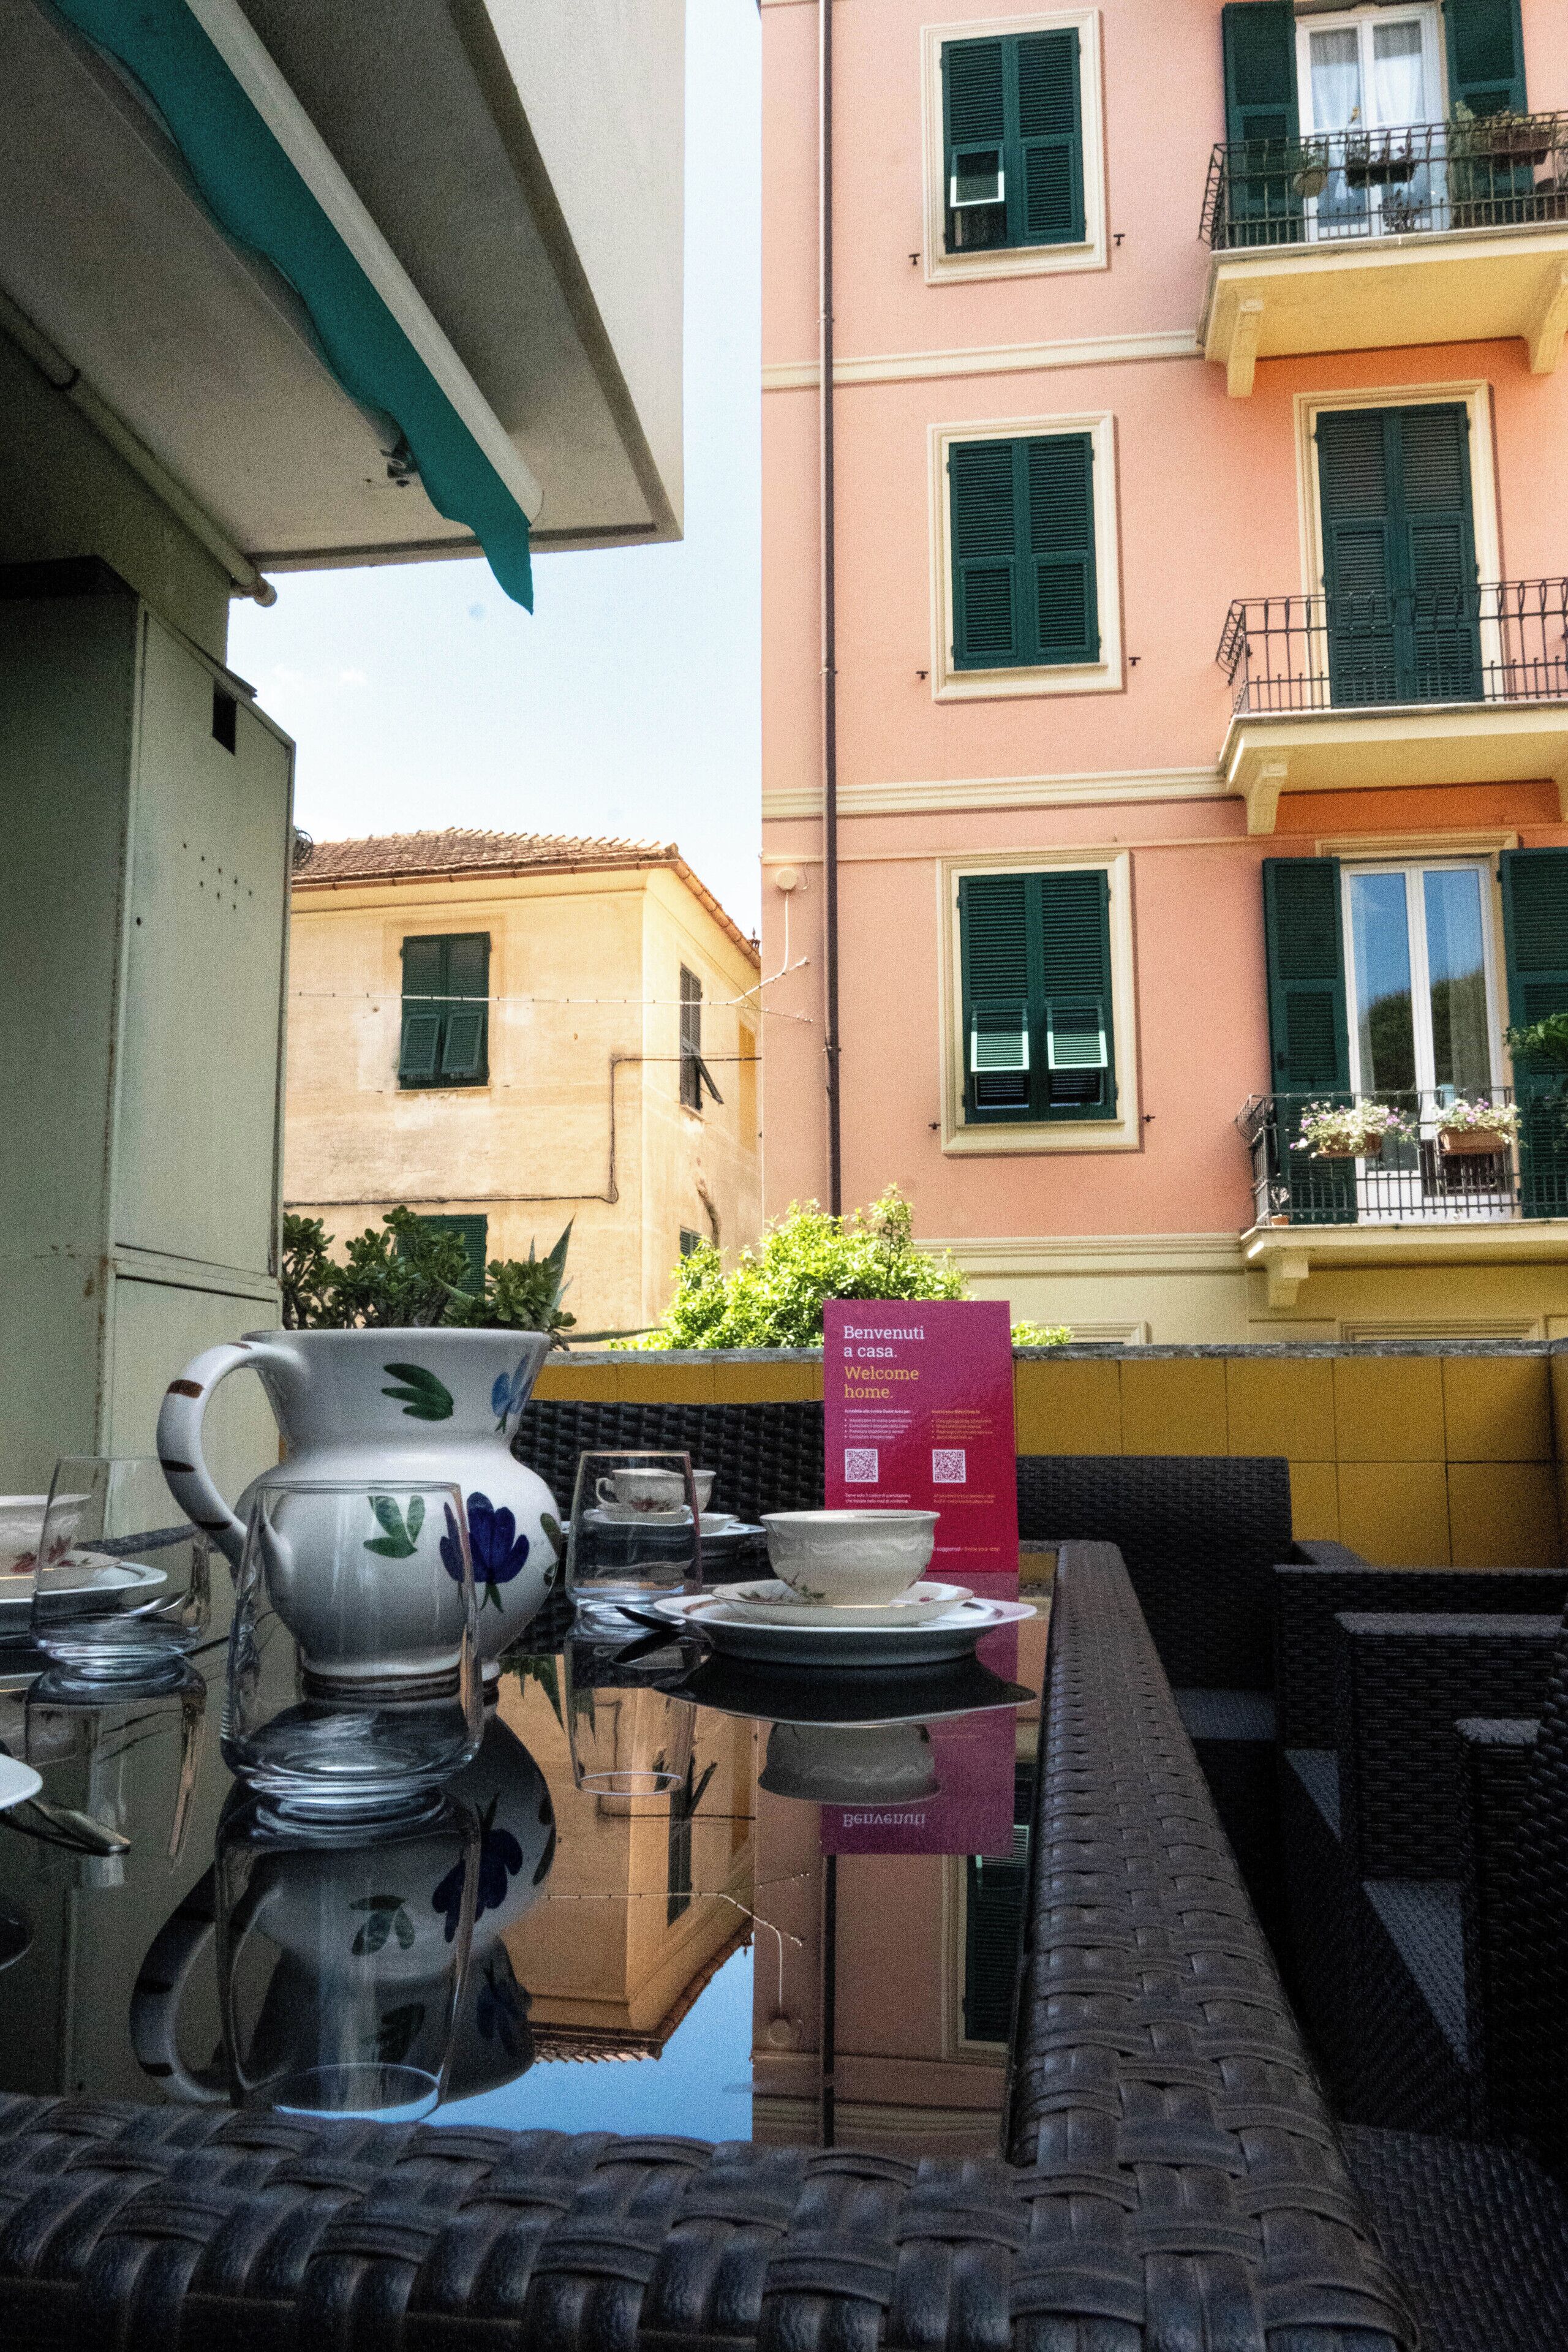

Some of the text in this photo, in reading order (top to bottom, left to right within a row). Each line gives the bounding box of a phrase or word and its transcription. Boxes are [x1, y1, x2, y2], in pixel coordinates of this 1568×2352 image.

[843, 1325, 925, 1340] Benvenuti
[843, 1346, 897, 1358] a casa.
[844, 1365, 919, 1380] Welcome
[844, 1384, 894, 1398] home.
